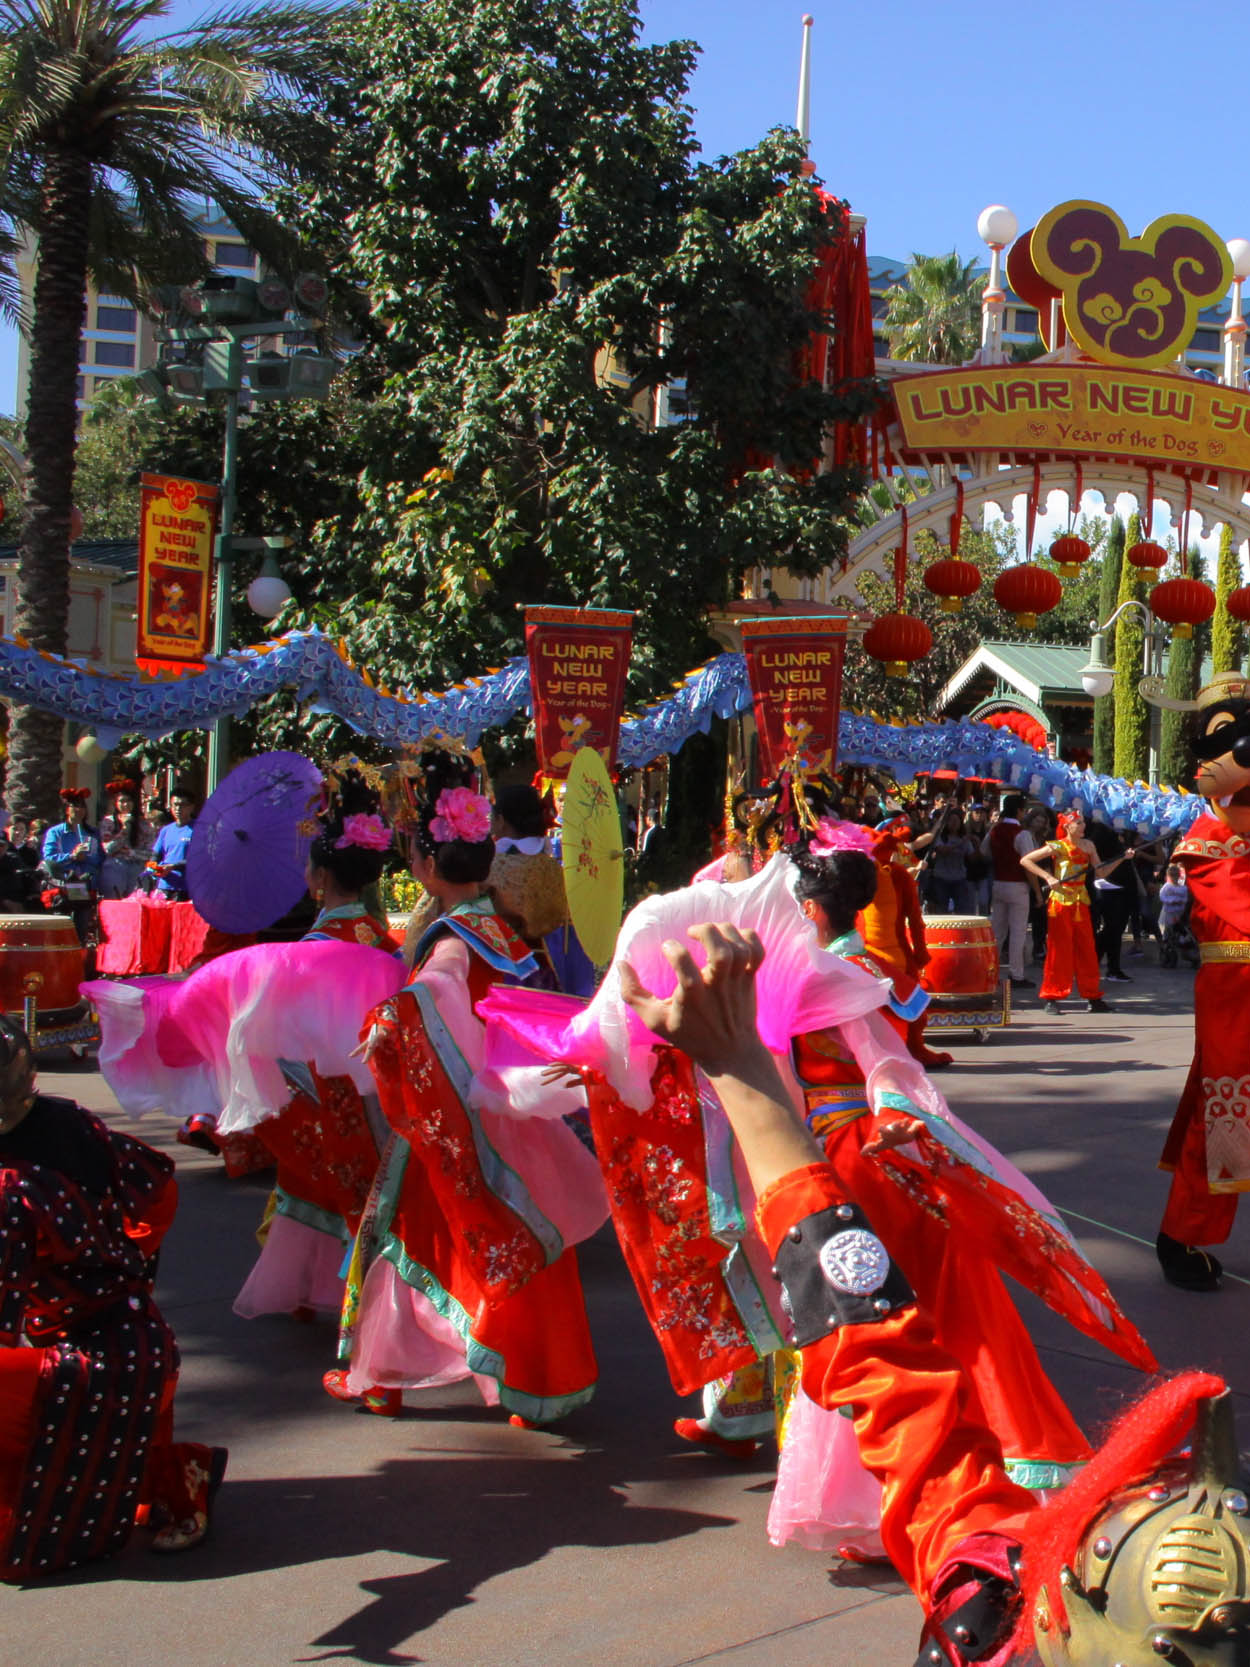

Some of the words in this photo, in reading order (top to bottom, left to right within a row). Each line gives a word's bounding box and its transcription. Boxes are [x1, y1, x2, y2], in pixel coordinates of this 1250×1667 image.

[909, 379, 1072, 423] LUNAR
[1088, 379, 1194, 424] NEW
[1056, 423, 1101, 442] Year
[1107, 428, 1126, 445] of
[1130, 430, 1156, 448] the
[1163, 433, 1199, 456] Dog
[151, 513, 206, 534] LUNAR
[160, 531, 197, 549] NEW
[154, 547, 200, 566] YEAR
[542, 643, 614, 660] LUNAR
[761, 652, 831, 667] LUNAR
[553, 661, 603, 678] NEW
[774, 669, 821, 684] NEW
[546, 680, 608, 696] YEAR
[769, 687, 827, 702] YEAR
